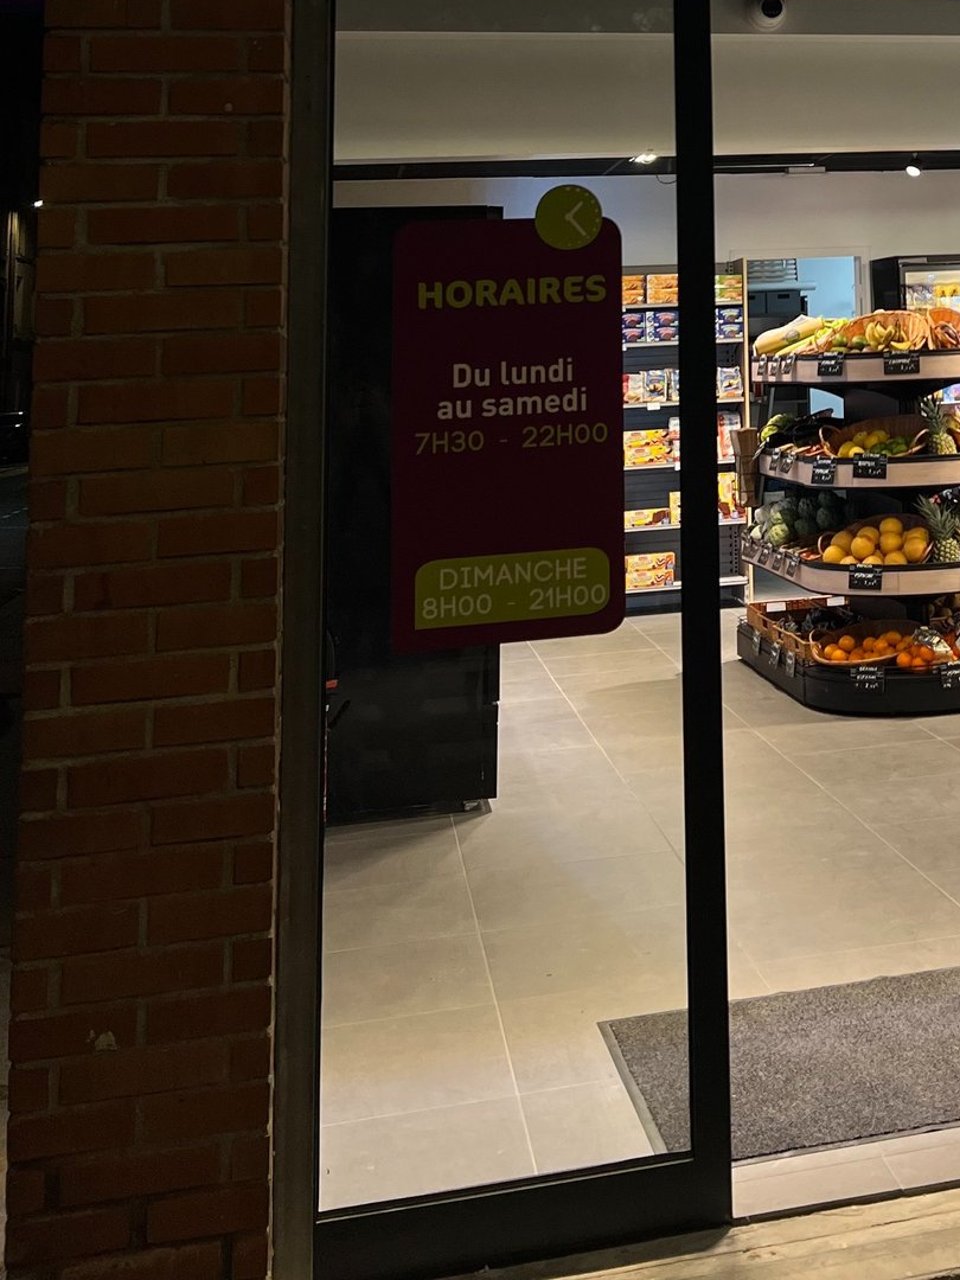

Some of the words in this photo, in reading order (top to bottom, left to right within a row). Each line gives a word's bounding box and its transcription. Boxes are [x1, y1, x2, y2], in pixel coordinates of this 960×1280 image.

[417, 274, 607, 310] HORAIRES
[452, 362, 491, 389] Du
[500, 357, 574, 386] lundi
[436, 399, 473, 420] au
[481, 386, 587, 417] samedi
[415, 430, 485, 456] 7H30
[521, 422, 609, 449] 22H00
[439, 557, 587, 591] DIMANCHE
[421, 593, 492, 620] 8H00
[528, 583, 606, 611] 21H00
